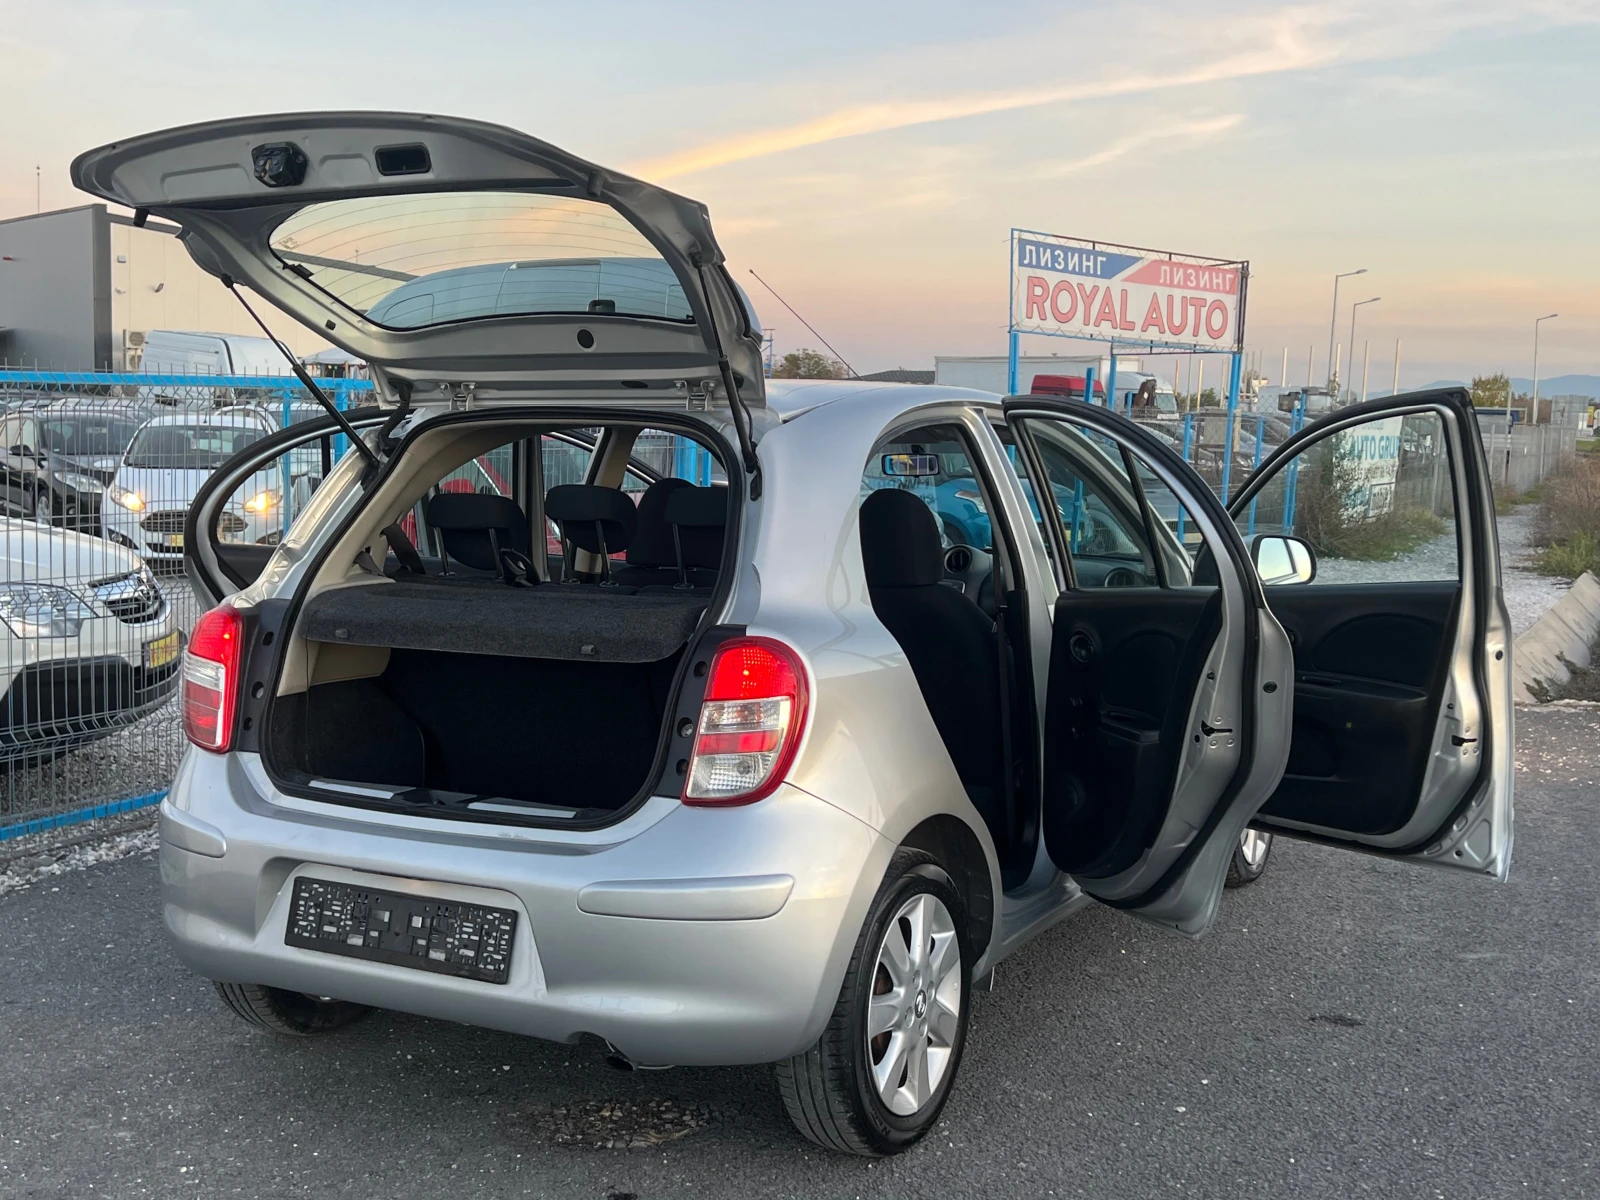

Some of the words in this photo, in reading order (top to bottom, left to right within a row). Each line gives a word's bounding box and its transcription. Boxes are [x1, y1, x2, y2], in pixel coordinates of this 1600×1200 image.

[1023, 244, 1106, 275] ЛИЗИНГ
[1159, 265, 1234, 291] ЛИЗИНГ
[1026, 275, 1136, 331] ROYAL
[1141, 292, 1228, 339] AUTO
